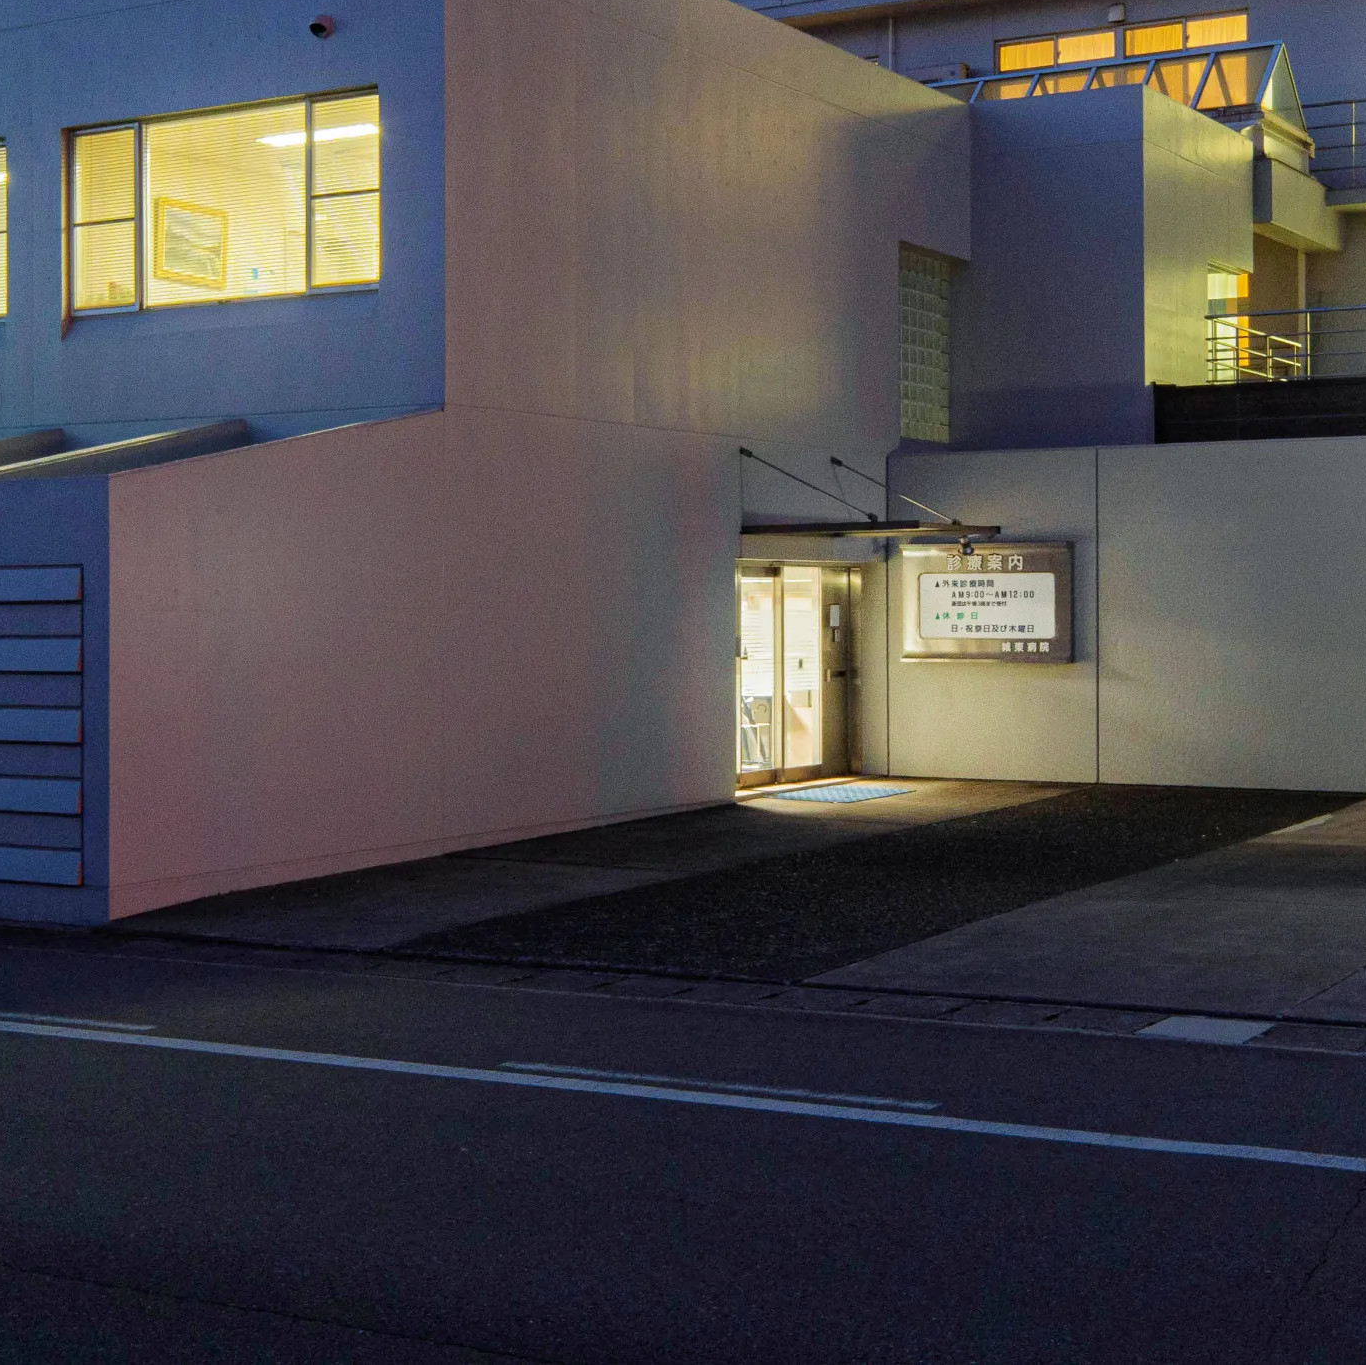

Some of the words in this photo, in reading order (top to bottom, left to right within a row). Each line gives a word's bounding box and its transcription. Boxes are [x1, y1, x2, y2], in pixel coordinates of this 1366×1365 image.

[946, 554, 1024, 571] 診療案内
[942, 579, 995, 588] 外来診療時間
[1001, 641, 1050, 653] 城東病院
